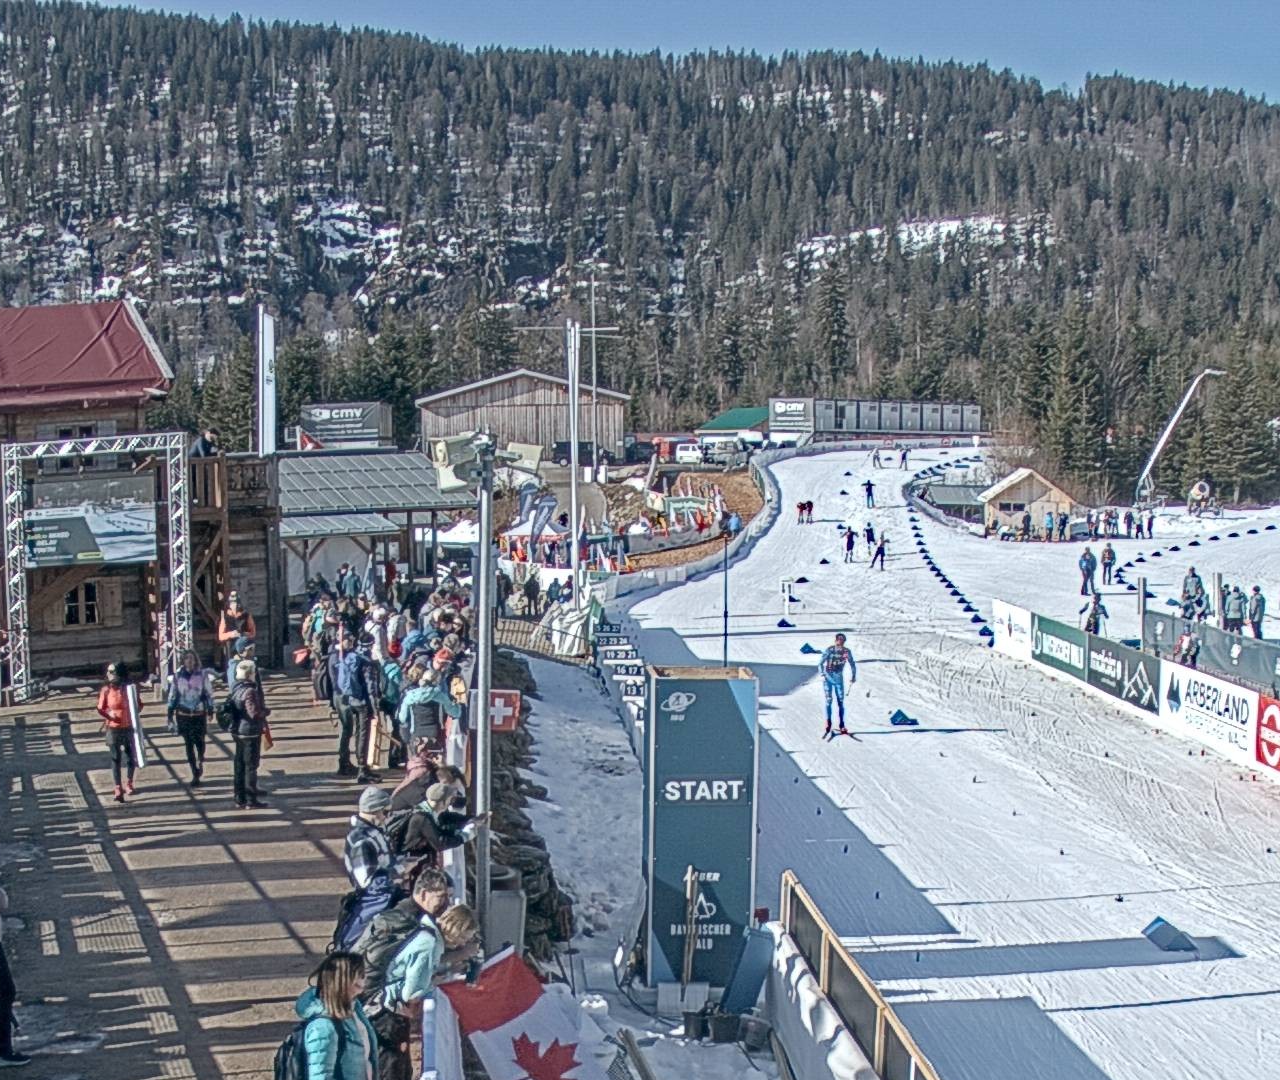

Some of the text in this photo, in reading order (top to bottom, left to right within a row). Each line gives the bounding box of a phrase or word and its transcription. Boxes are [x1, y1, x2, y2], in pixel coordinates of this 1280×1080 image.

[331, 407, 363, 419] cmv
[616, 666, 626, 675] 16
[628, 666, 638, 675] 17
[626, 685, 637, 696] 13
[1184, 678, 1250, 725] ARBERLAND
[665, 780, 744, 801] START
[671, 923, 732, 936] BAYISCHER
